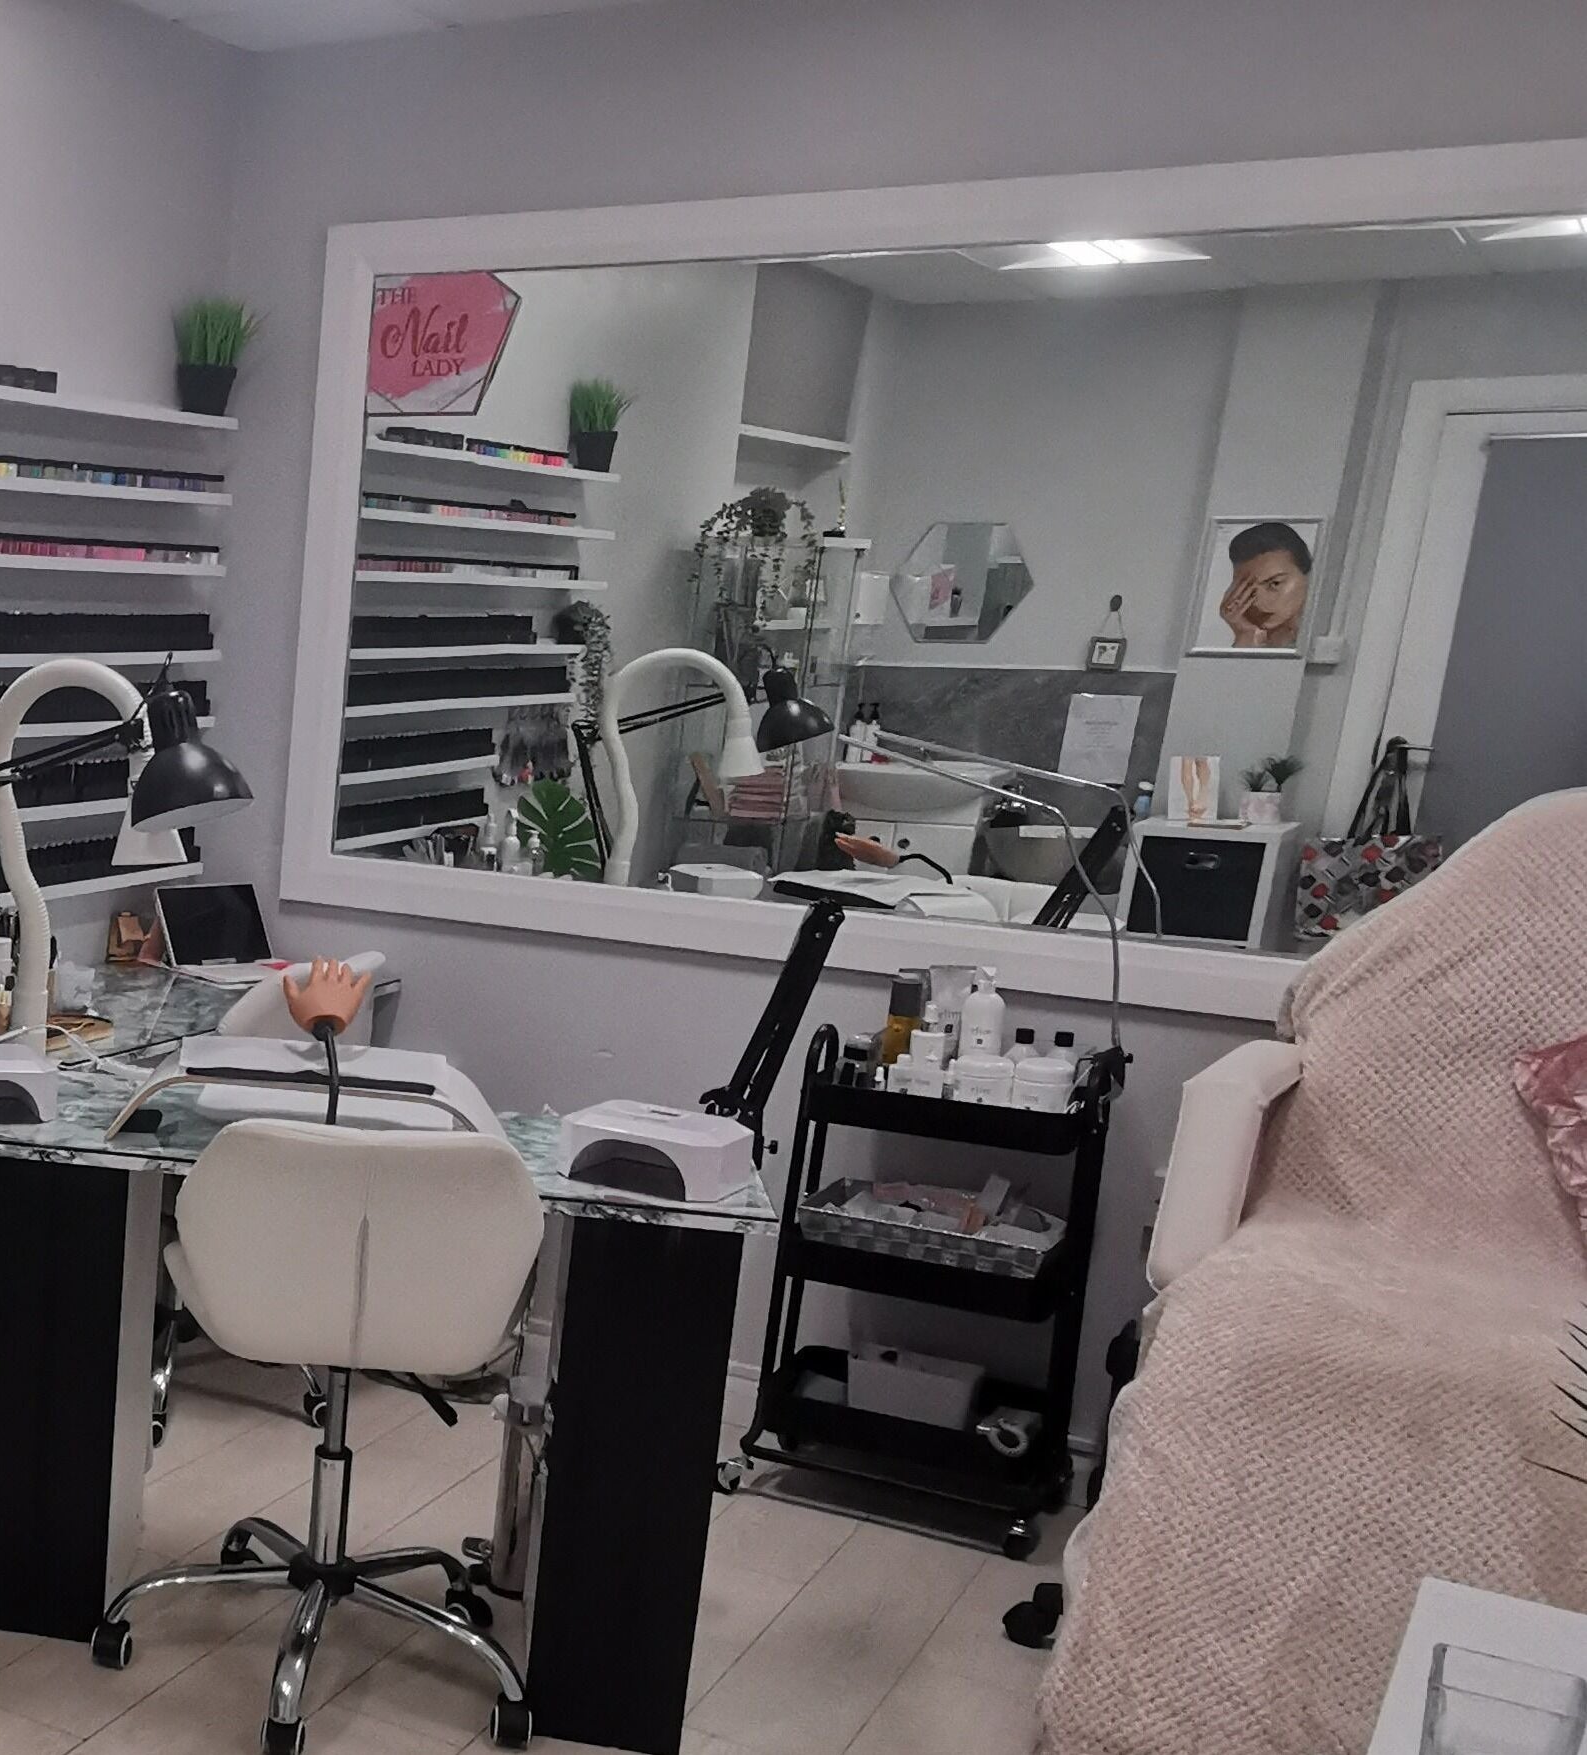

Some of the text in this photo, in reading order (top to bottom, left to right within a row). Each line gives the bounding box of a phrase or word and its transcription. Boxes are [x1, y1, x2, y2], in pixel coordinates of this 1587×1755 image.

[376, 287, 417, 305] THE
[380, 304, 469, 359] Nail
[412, 358, 466, 377] LADY
